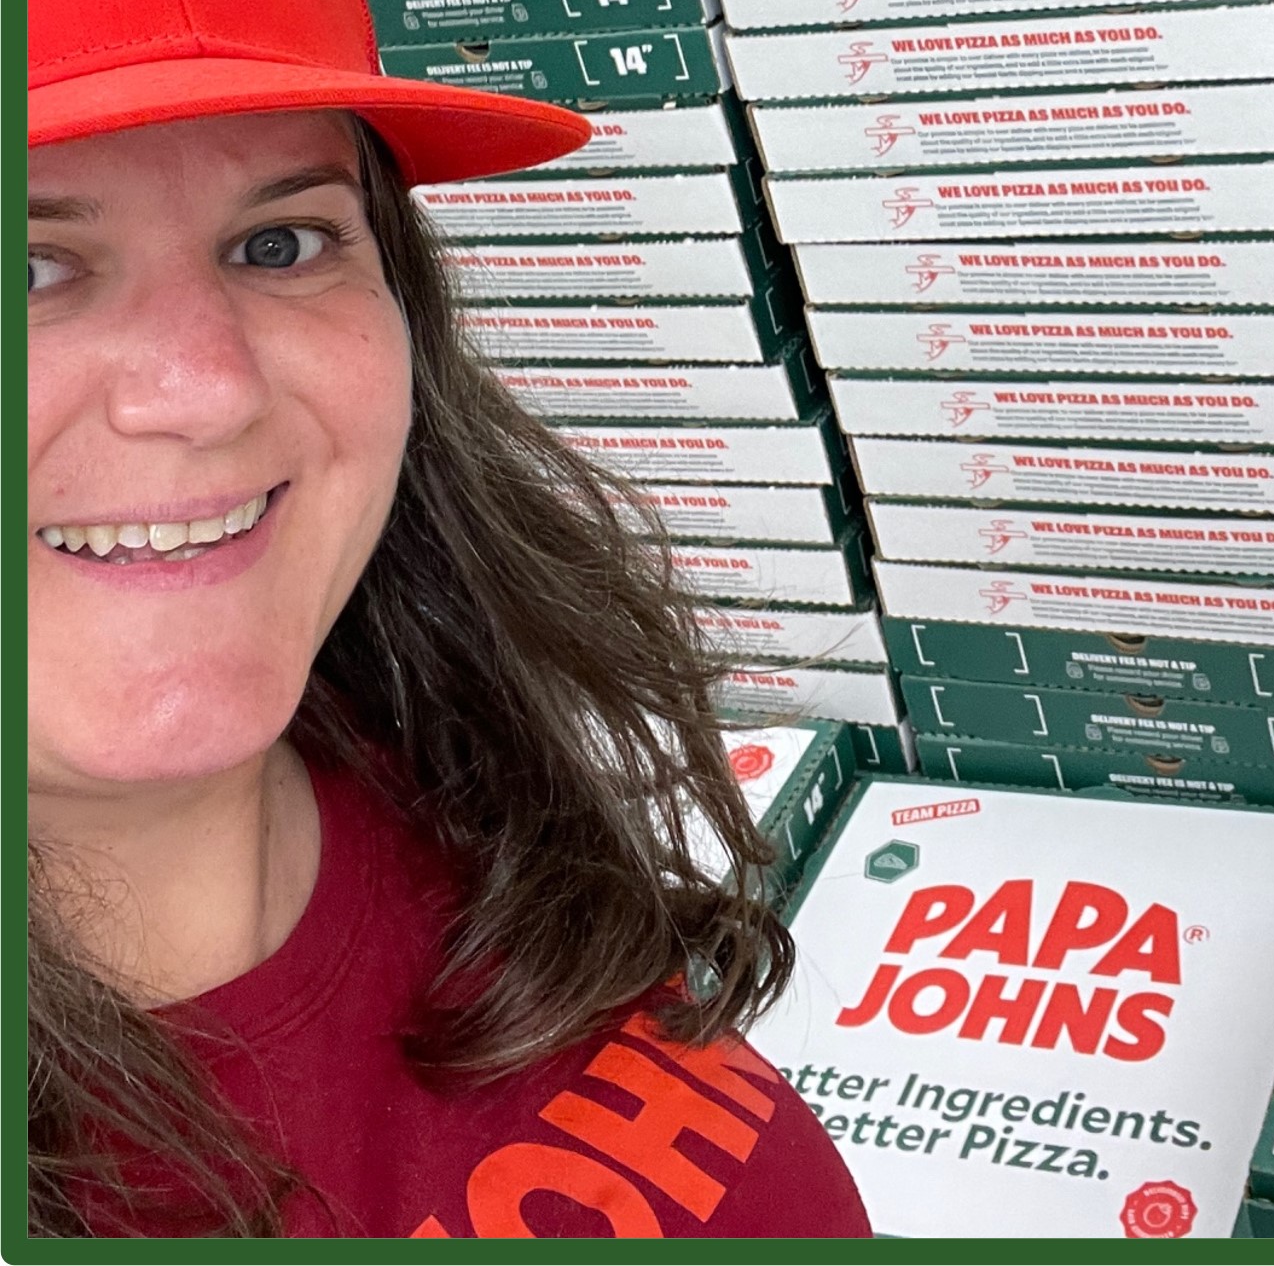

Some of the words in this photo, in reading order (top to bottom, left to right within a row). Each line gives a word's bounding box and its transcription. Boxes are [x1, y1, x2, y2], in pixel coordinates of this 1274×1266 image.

[610, 45, 652, 75] 14"
[895, 806, 934, 824] TEAM
[936, 800, 977, 817] PIZZA
[883, 879, 1182, 984] PAPA
[835, 963, 1175, 1062] JOHNS
[897, 1073, 1213, 1151] Ingredients.
[958, 1121, 1109, 1181] Pizza.
